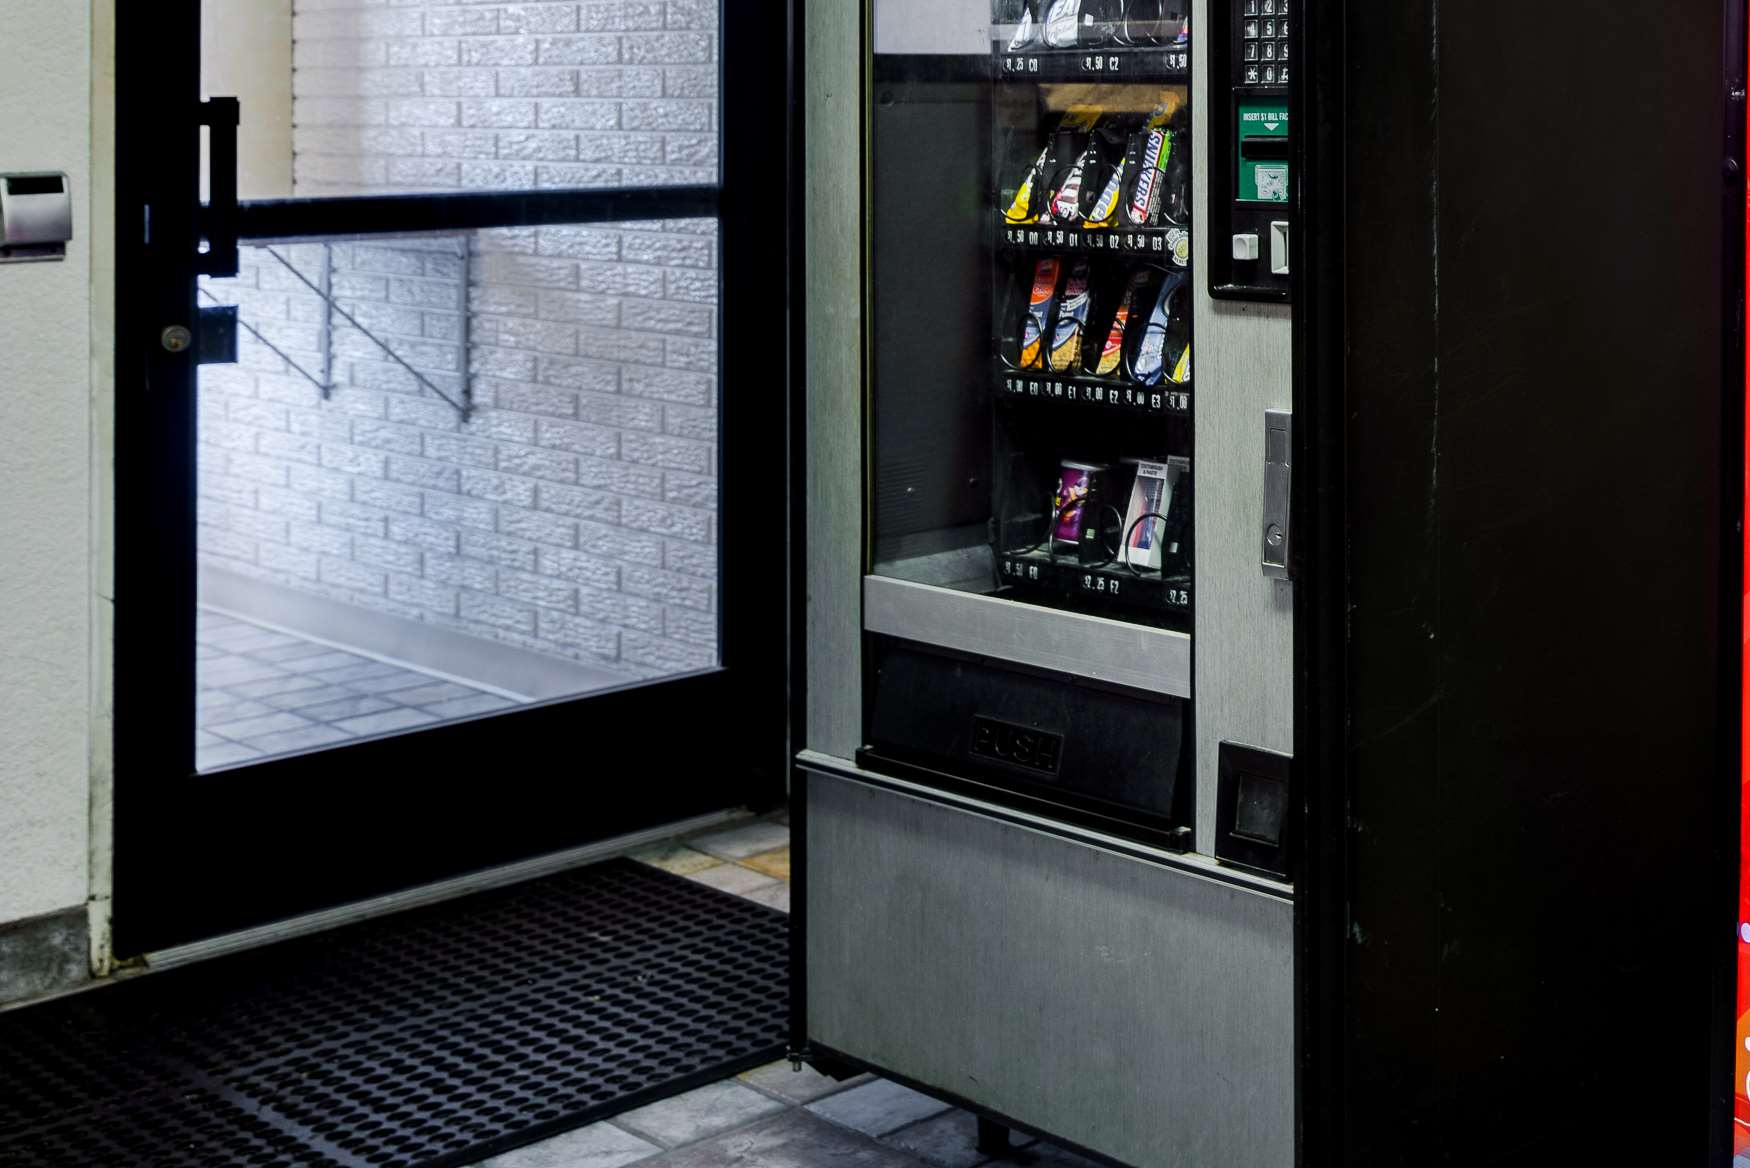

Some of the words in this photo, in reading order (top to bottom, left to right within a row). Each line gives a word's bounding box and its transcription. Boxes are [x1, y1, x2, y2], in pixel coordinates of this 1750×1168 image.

[1265, 0, 1273, 12] 2
[1266, 21, 1273, 35] 5
[1250, 44, 1255, 58] 7
[1266, 44, 1273, 58] 8
[1028, 58, 1038, 72] C0
[1109, 56, 1119, 71] C2
[1243, 112, 1260, 121] INSERT
[1267, 112, 1278, 121] BILL
[1068, 385, 1077, 399] E1
[1109, 389, 1119, 404] E2
[1151, 394, 1161, 409] E3
[1110, 579, 1119, 594] F2
[973, 726, 1057, 769] PUSH
